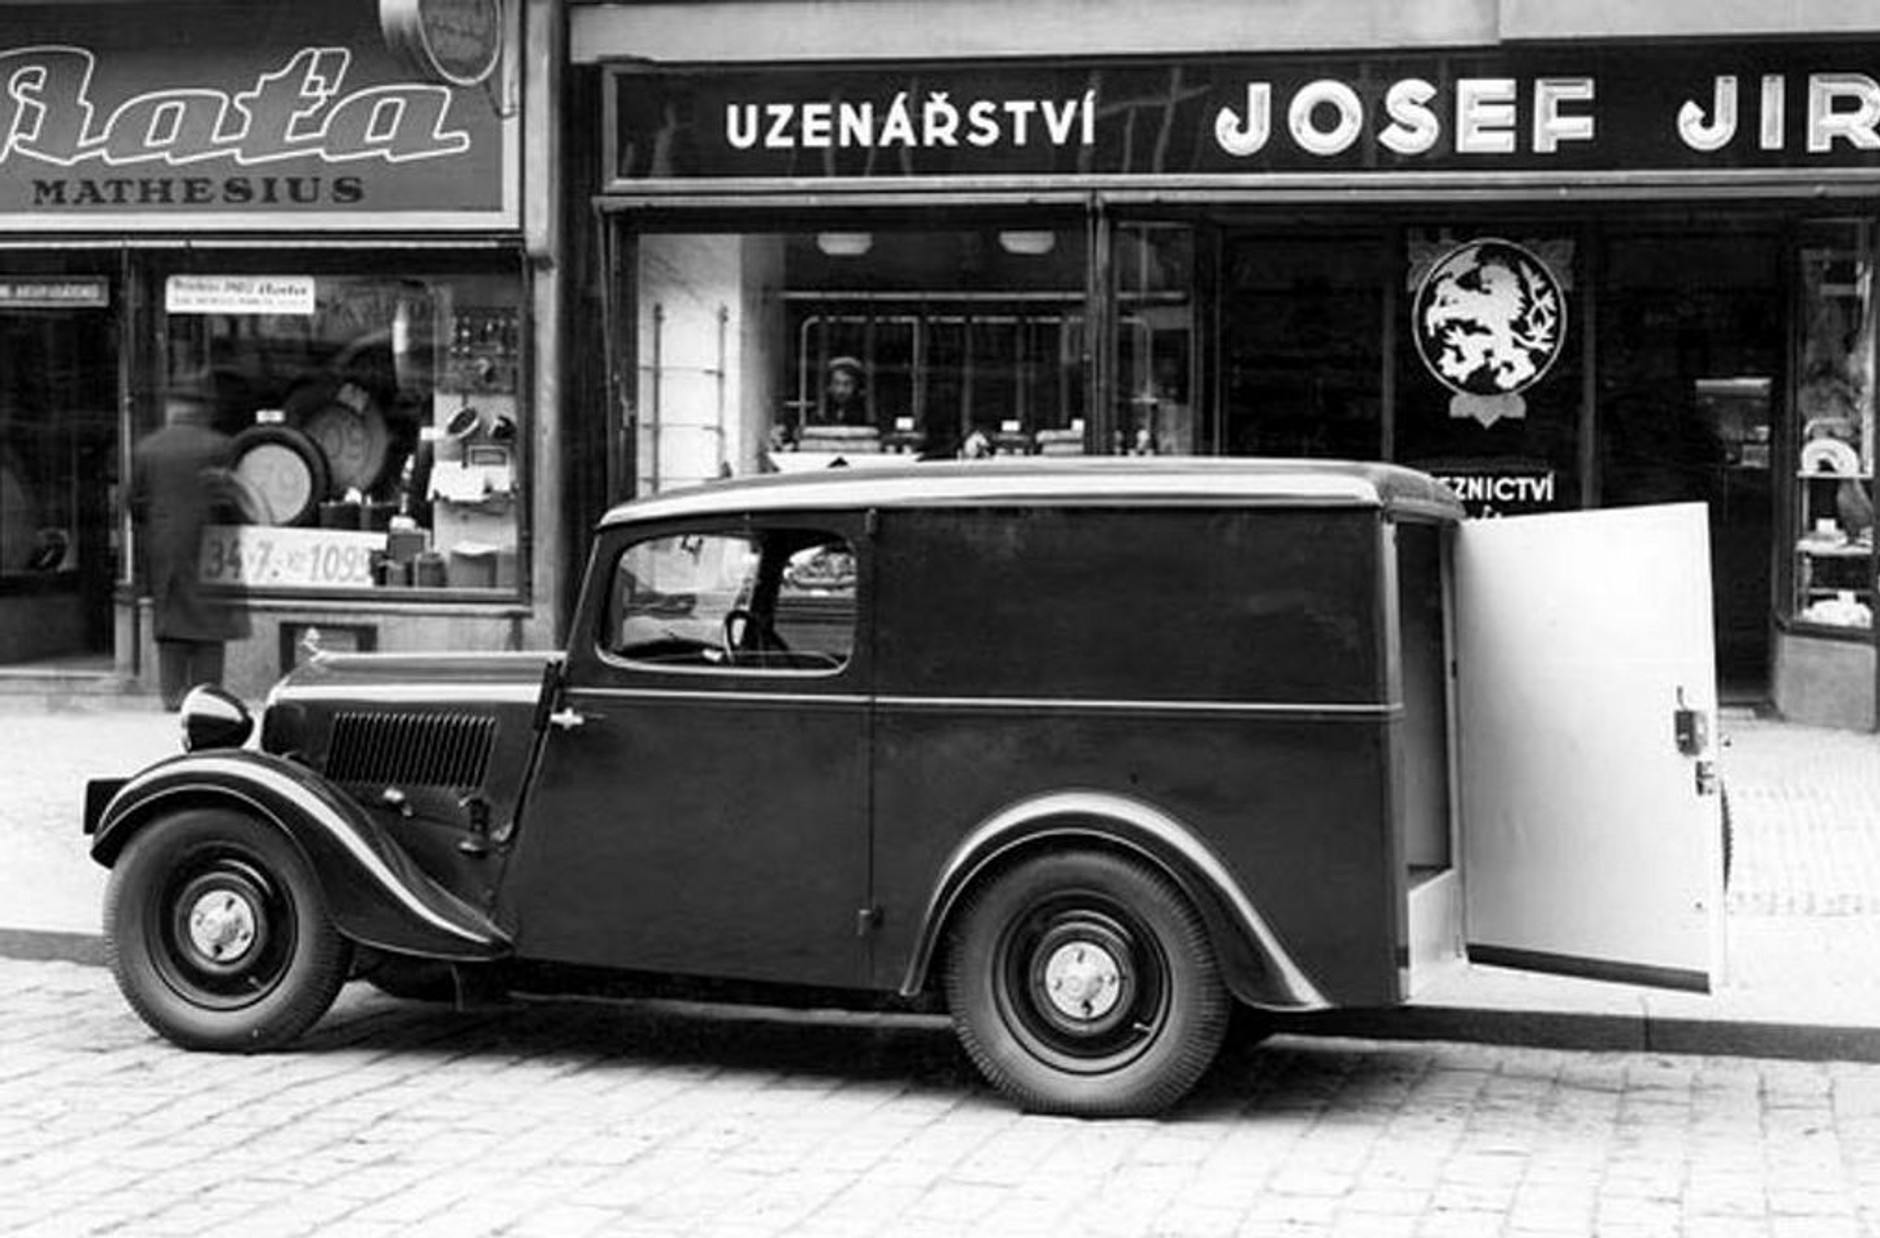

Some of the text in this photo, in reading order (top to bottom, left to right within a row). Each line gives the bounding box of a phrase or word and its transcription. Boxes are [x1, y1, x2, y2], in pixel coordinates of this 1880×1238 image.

[727, 74, 1880, 156] UZENÁŘSTVÍ JOSEF JIR
[32, 176, 365, 205] MATHESIUS
[1437, 471, 1555, 502] ZNICTVÍ
